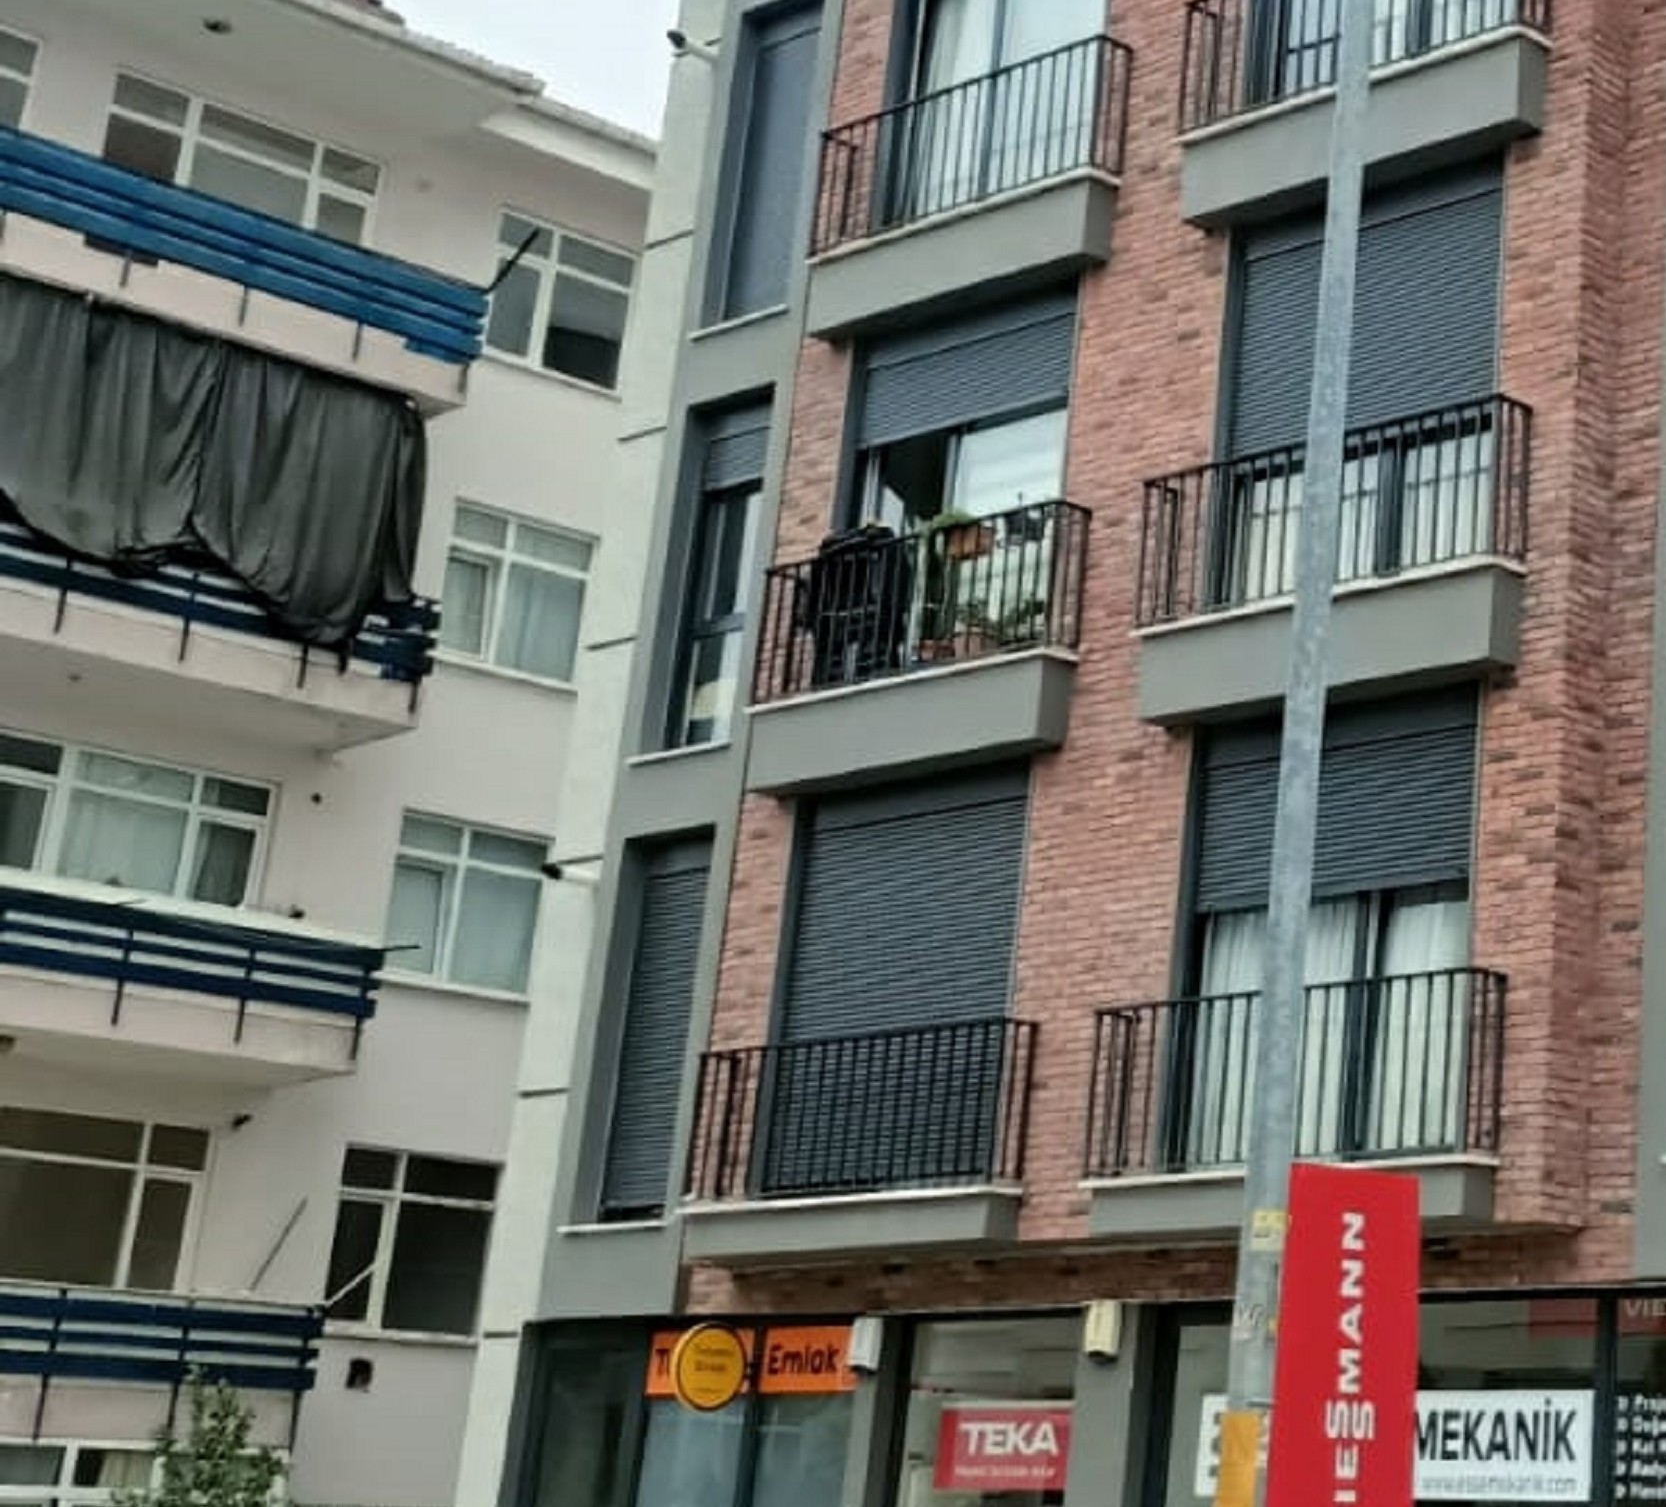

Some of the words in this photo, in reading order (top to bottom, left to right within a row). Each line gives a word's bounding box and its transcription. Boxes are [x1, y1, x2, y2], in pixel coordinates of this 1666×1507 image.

[766, 1344, 840, 1375] Emlak
[959, 1420, 1059, 1457] TEKA
[1414, 1398, 1577, 1462] MEKANİK
